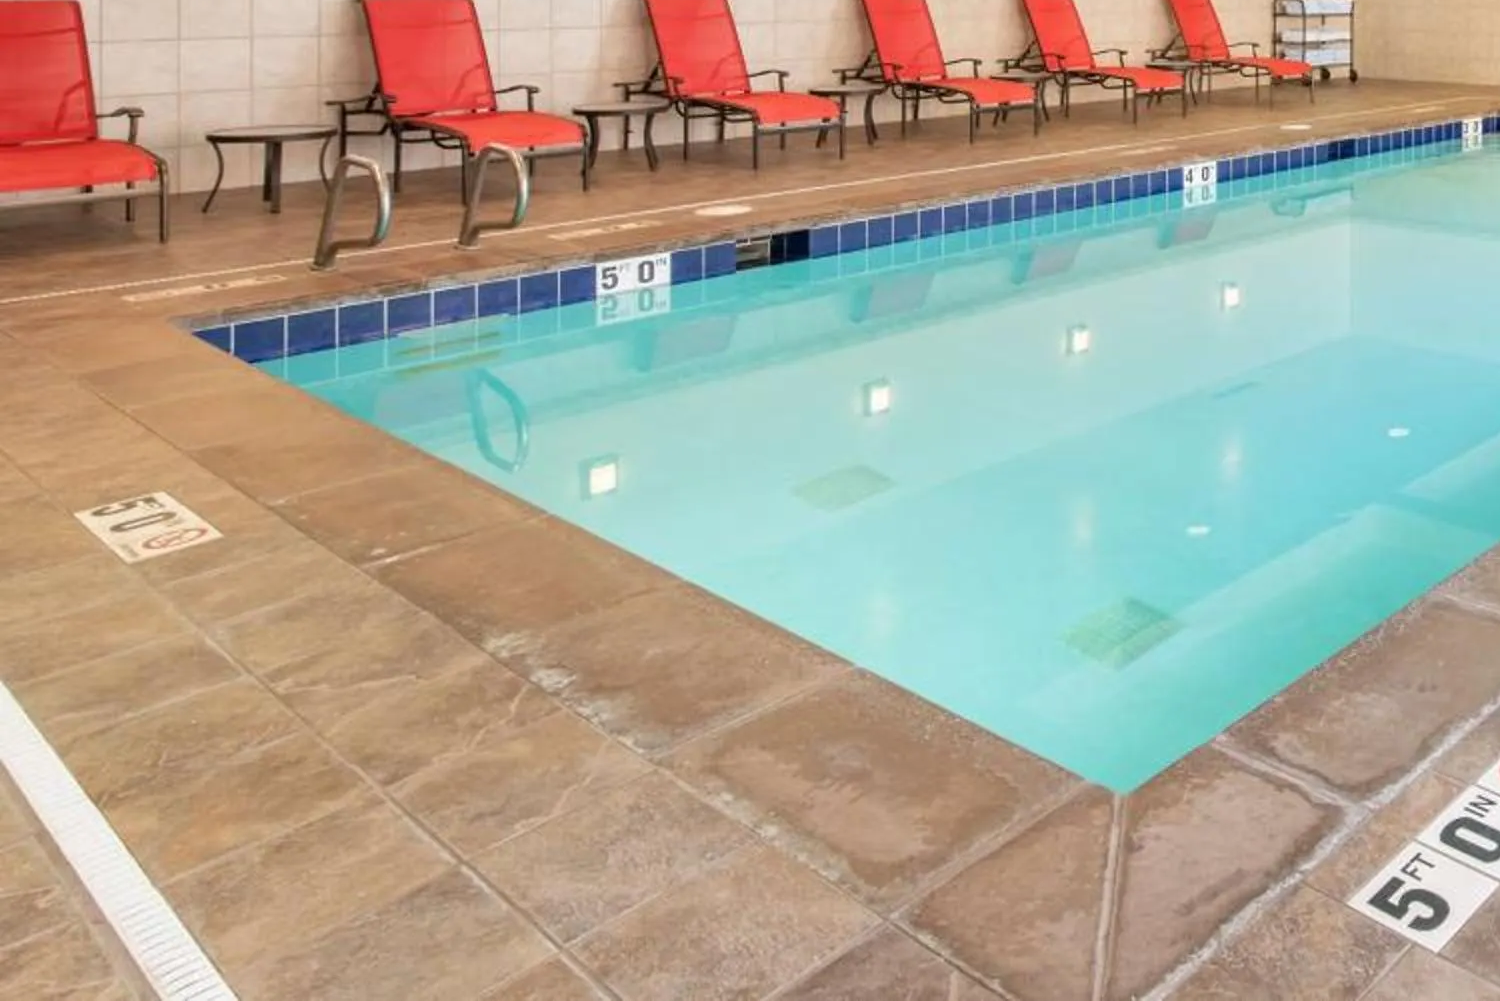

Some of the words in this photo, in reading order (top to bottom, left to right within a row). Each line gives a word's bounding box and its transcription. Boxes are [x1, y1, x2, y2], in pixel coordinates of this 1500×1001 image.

[1185, 168, 1193, 184] 4
[1201, 166, 1209, 182] 0
[601, 266, 619, 290] 5
[638, 260, 654, 284] 0
[109, 511, 178, 533] 0
[1464, 794, 1498, 818] IN
[1401, 852, 1436, 882] FT
[1366, 876, 1451, 932] 5
